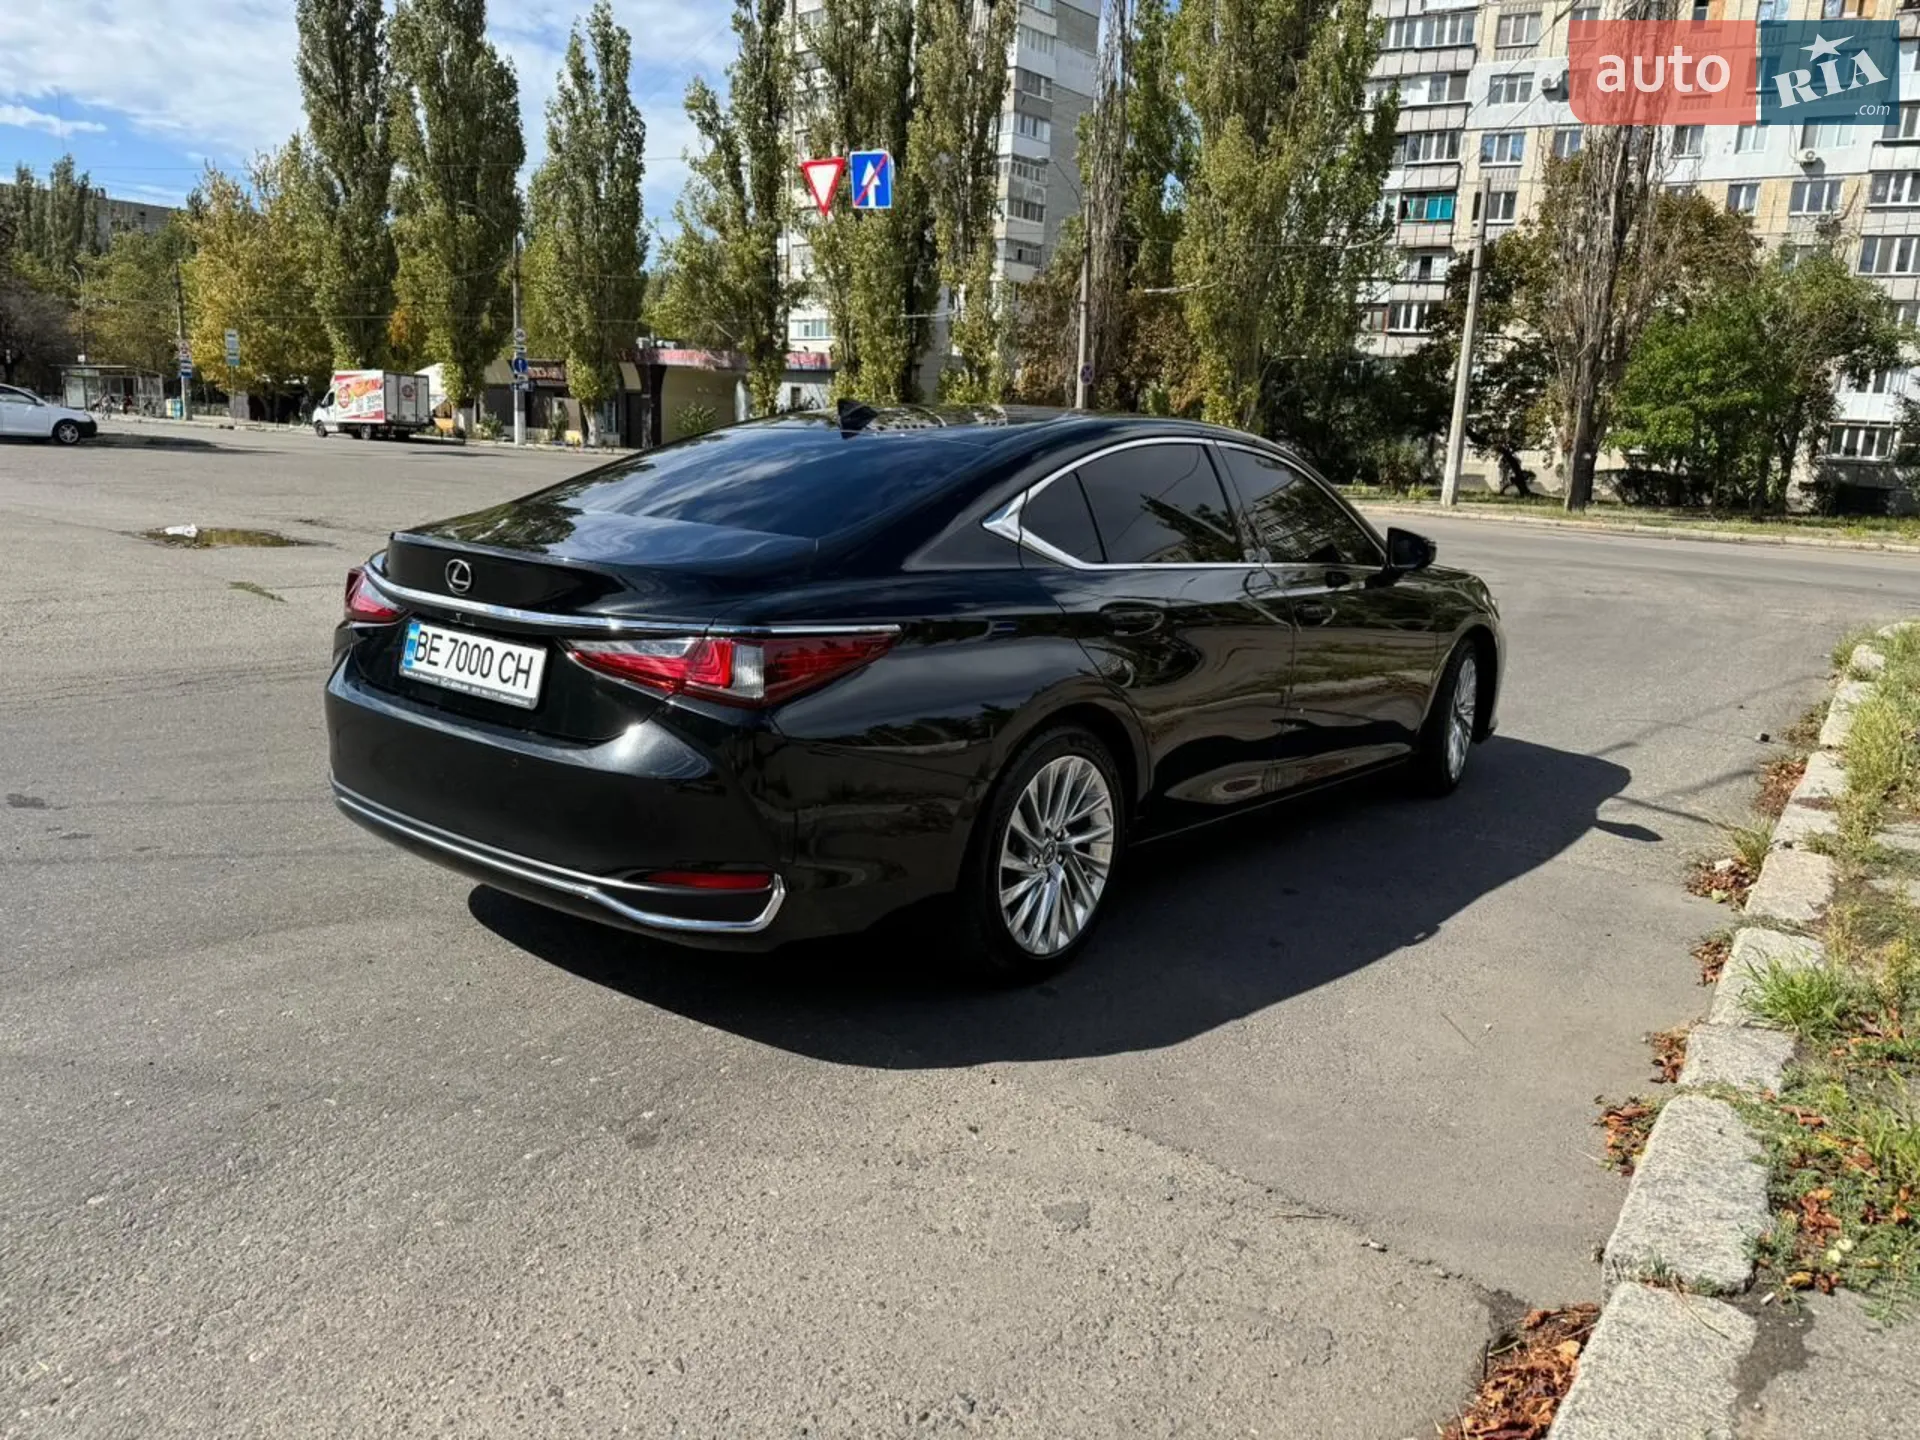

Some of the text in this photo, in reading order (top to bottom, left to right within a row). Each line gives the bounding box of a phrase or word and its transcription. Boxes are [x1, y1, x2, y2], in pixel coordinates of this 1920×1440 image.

[415, 631, 443, 667] BE
[444, 638, 495, 679] 7000
[497, 651, 534, 690] CH
